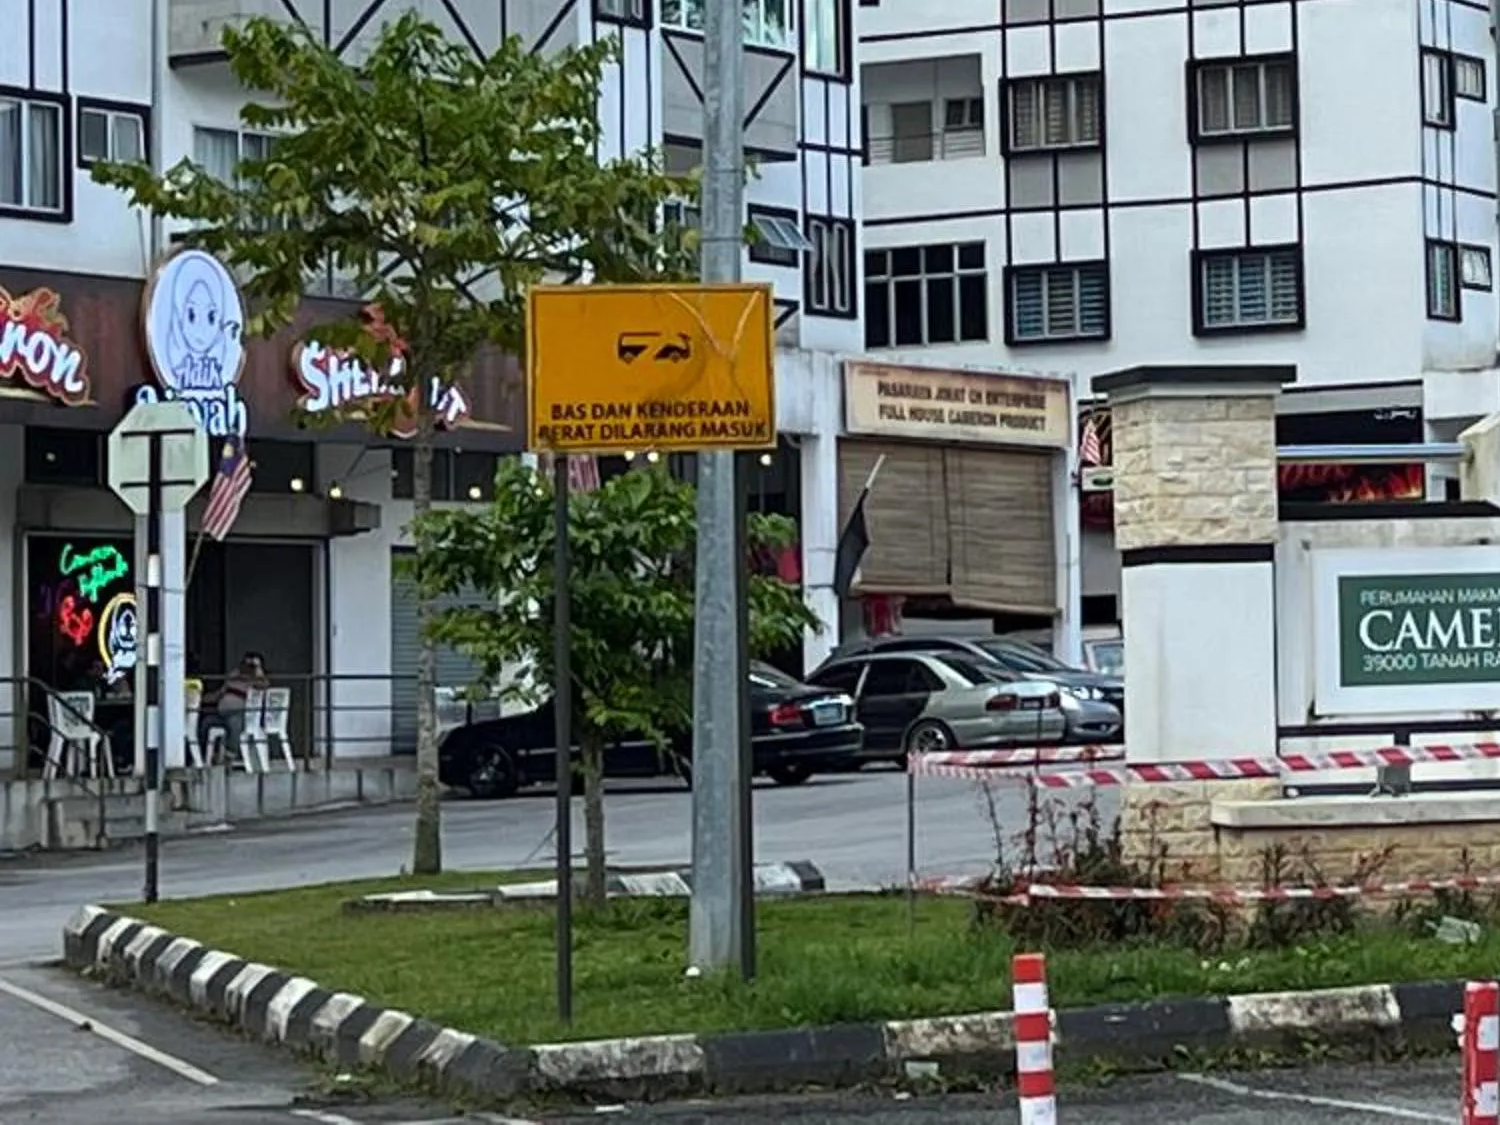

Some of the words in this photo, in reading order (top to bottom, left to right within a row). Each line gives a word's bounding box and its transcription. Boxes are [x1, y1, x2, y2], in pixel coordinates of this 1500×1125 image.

[551, 403, 587, 420] BAS
[592, 402, 632, 420] DAN
[637, 400, 750, 419] KENDERAAN
[601, 422, 696, 440] DILARANG
[701, 420, 767, 437] MASUK
[1000, 412, 1046, 431] PRODUCT
[1360, 589, 1454, 605] PERUMAHAN
[1363, 654, 1418, 672] 39000
[1421, 652, 1480, 669] TANAH
